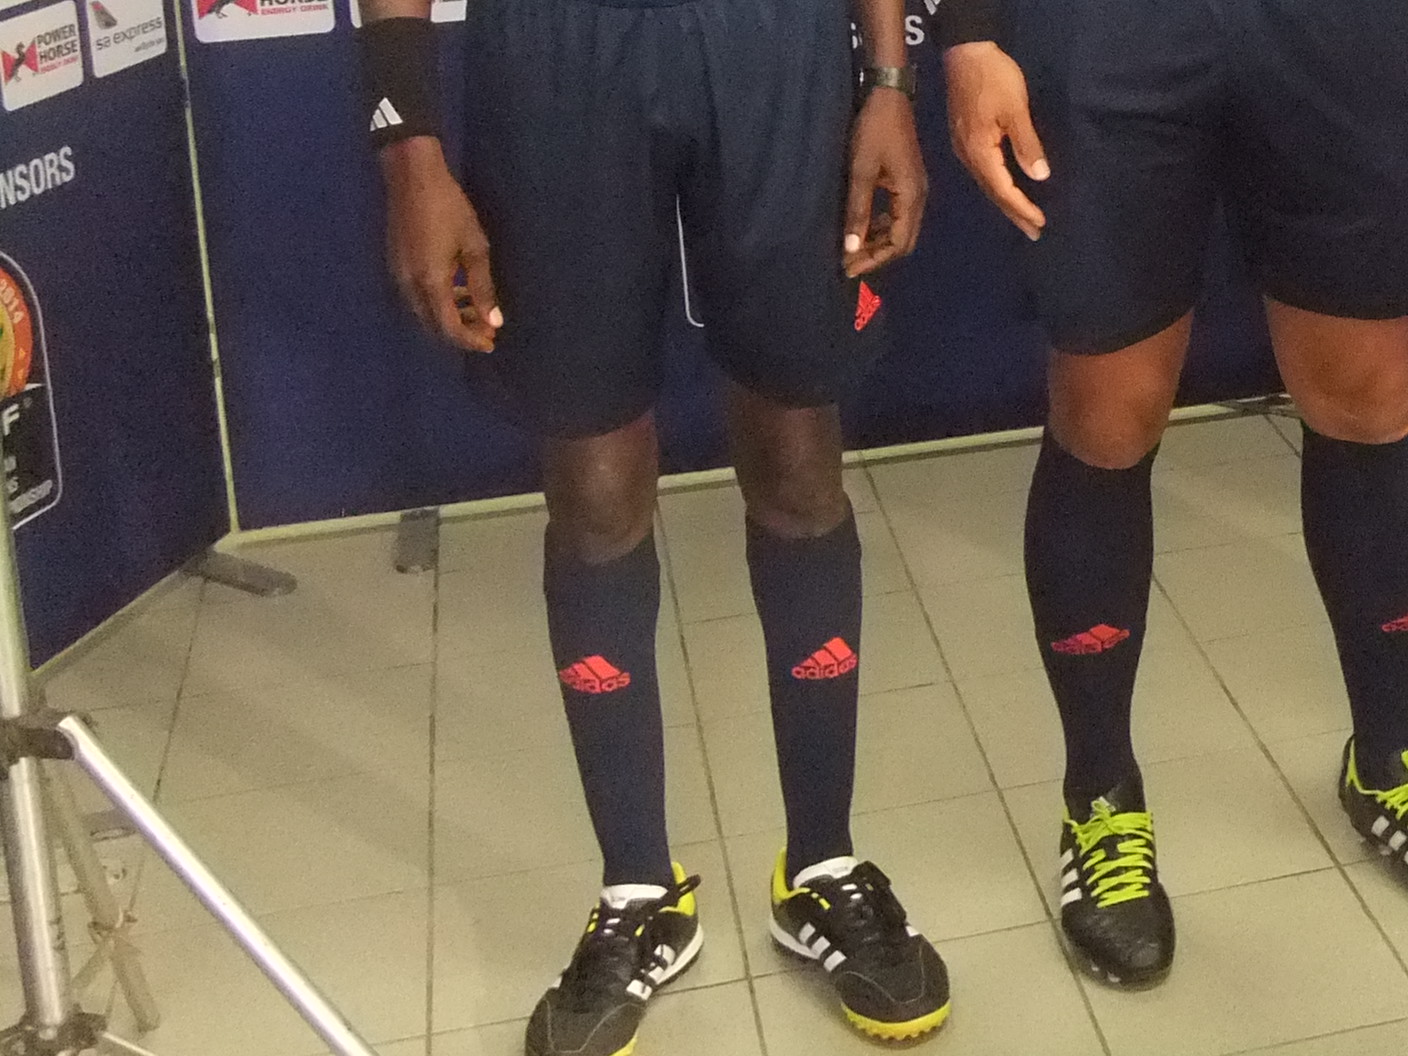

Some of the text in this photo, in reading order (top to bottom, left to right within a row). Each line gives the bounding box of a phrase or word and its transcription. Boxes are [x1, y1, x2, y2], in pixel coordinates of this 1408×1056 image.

[36, 23, 77, 46] POWER
[96, 17, 163, 50] sa express
[38, 40, 78, 63] HORSE
[0, 145, 75, 208] NSORS
